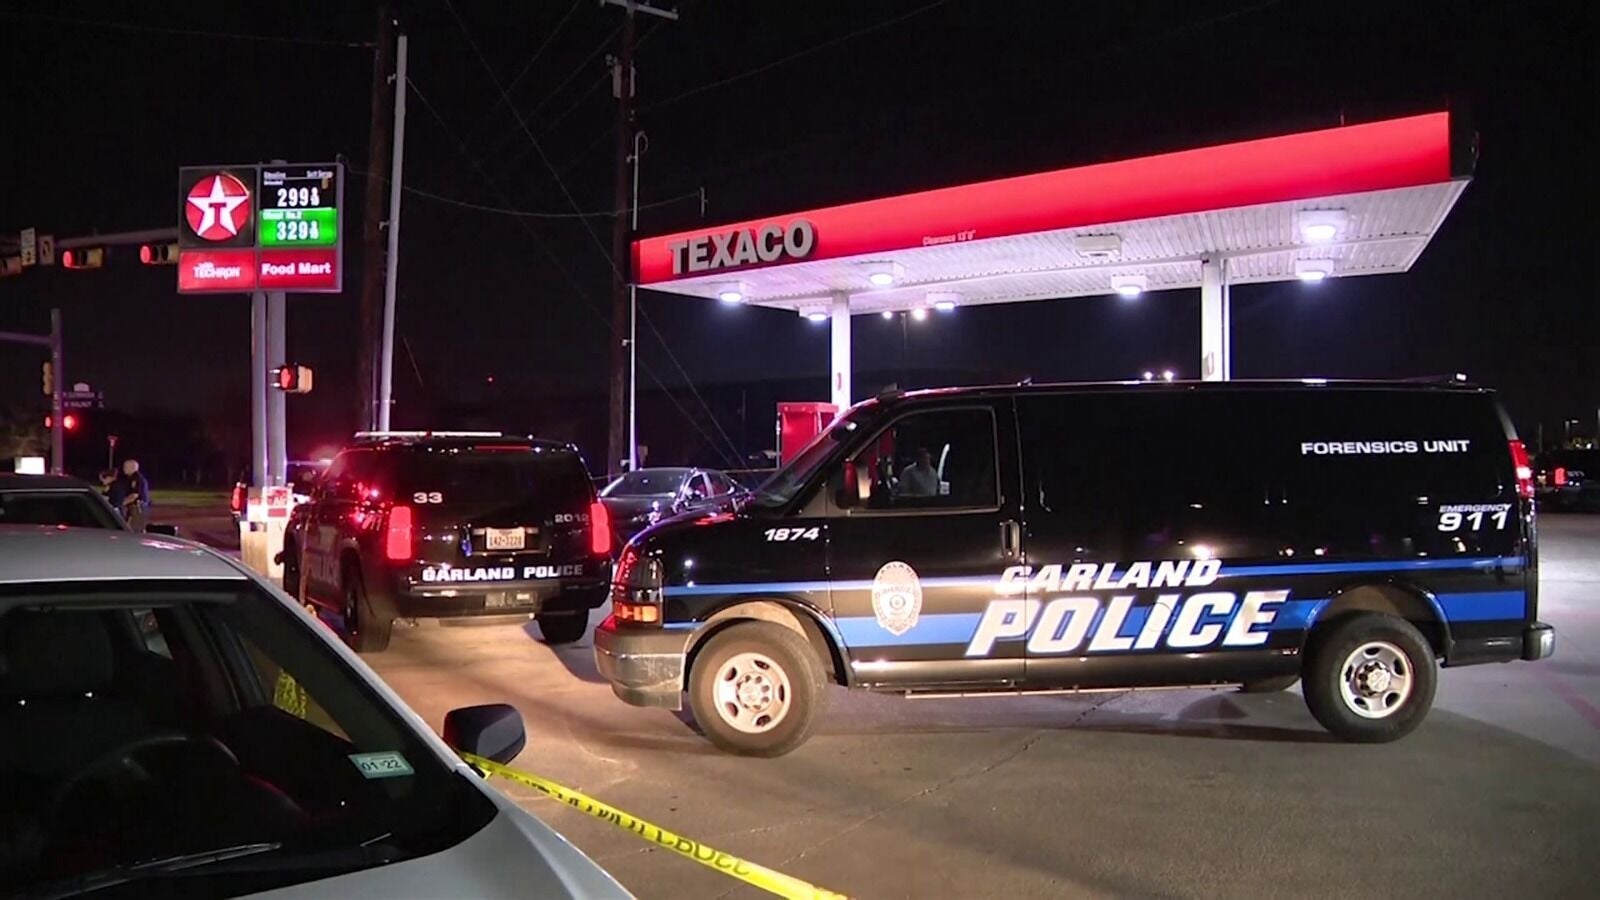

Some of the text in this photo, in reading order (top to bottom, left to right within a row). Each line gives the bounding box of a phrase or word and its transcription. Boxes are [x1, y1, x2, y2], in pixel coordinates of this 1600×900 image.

[668, 221, 815, 275] TEXACO
[261, 262, 331, 276] Food Mart
[1301, 440, 1470, 455] FORENSICS UNIT
[413, 492, 443, 504] 33
[1438, 503, 1512, 513] EMERGENCY
[1437, 512, 1508, 532] 911
[763, 527, 820, 542] 1874
[422, 564, 584, 582] GARLAND POLICE
[997, 558, 1224, 593] GARLAND
[965, 589, 1292, 658] POLICE
